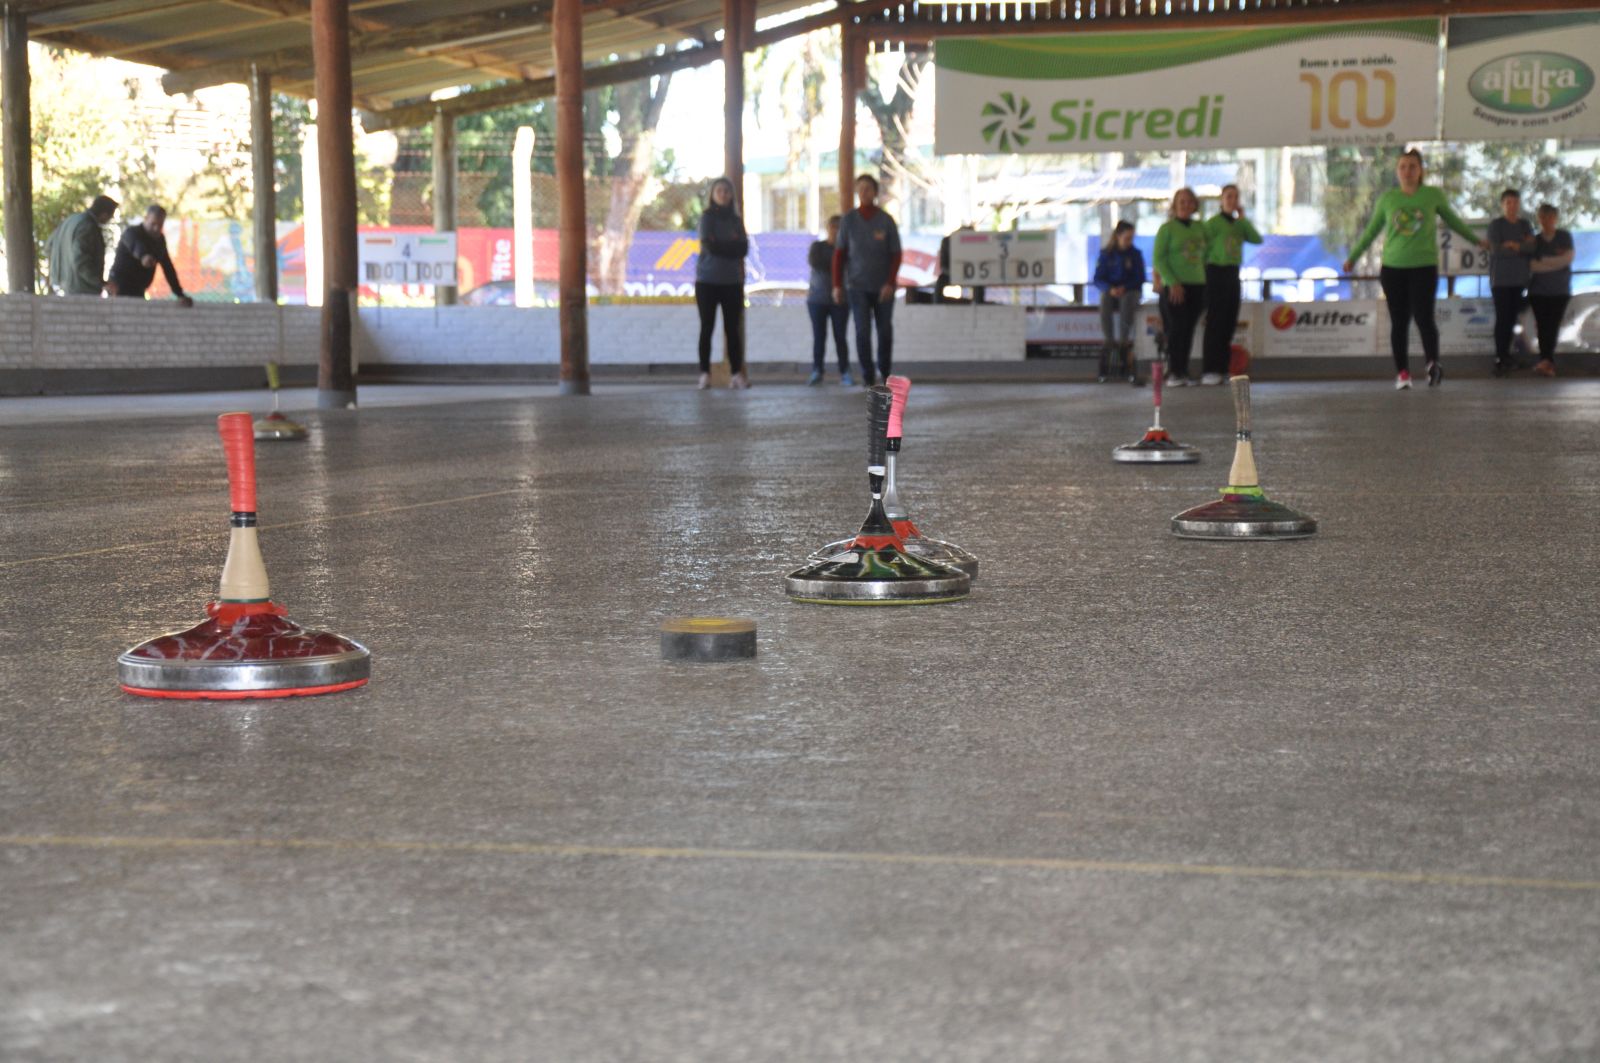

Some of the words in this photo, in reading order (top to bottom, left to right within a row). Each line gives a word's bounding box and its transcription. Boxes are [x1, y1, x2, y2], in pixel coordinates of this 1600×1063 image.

[1482, 56, 1579, 109] afubra
[1299, 69, 1397, 130] 100
[1047, 95, 1225, 143] Sicredi
[1440, 230, 1452, 250] 2
[401, 242, 412, 259] 4
[1461, 249, 1489, 269] 03
[963, 260, 990, 279] 05
[1016, 260, 1043, 279] 00
[1296, 310, 1369, 326] Aritec
